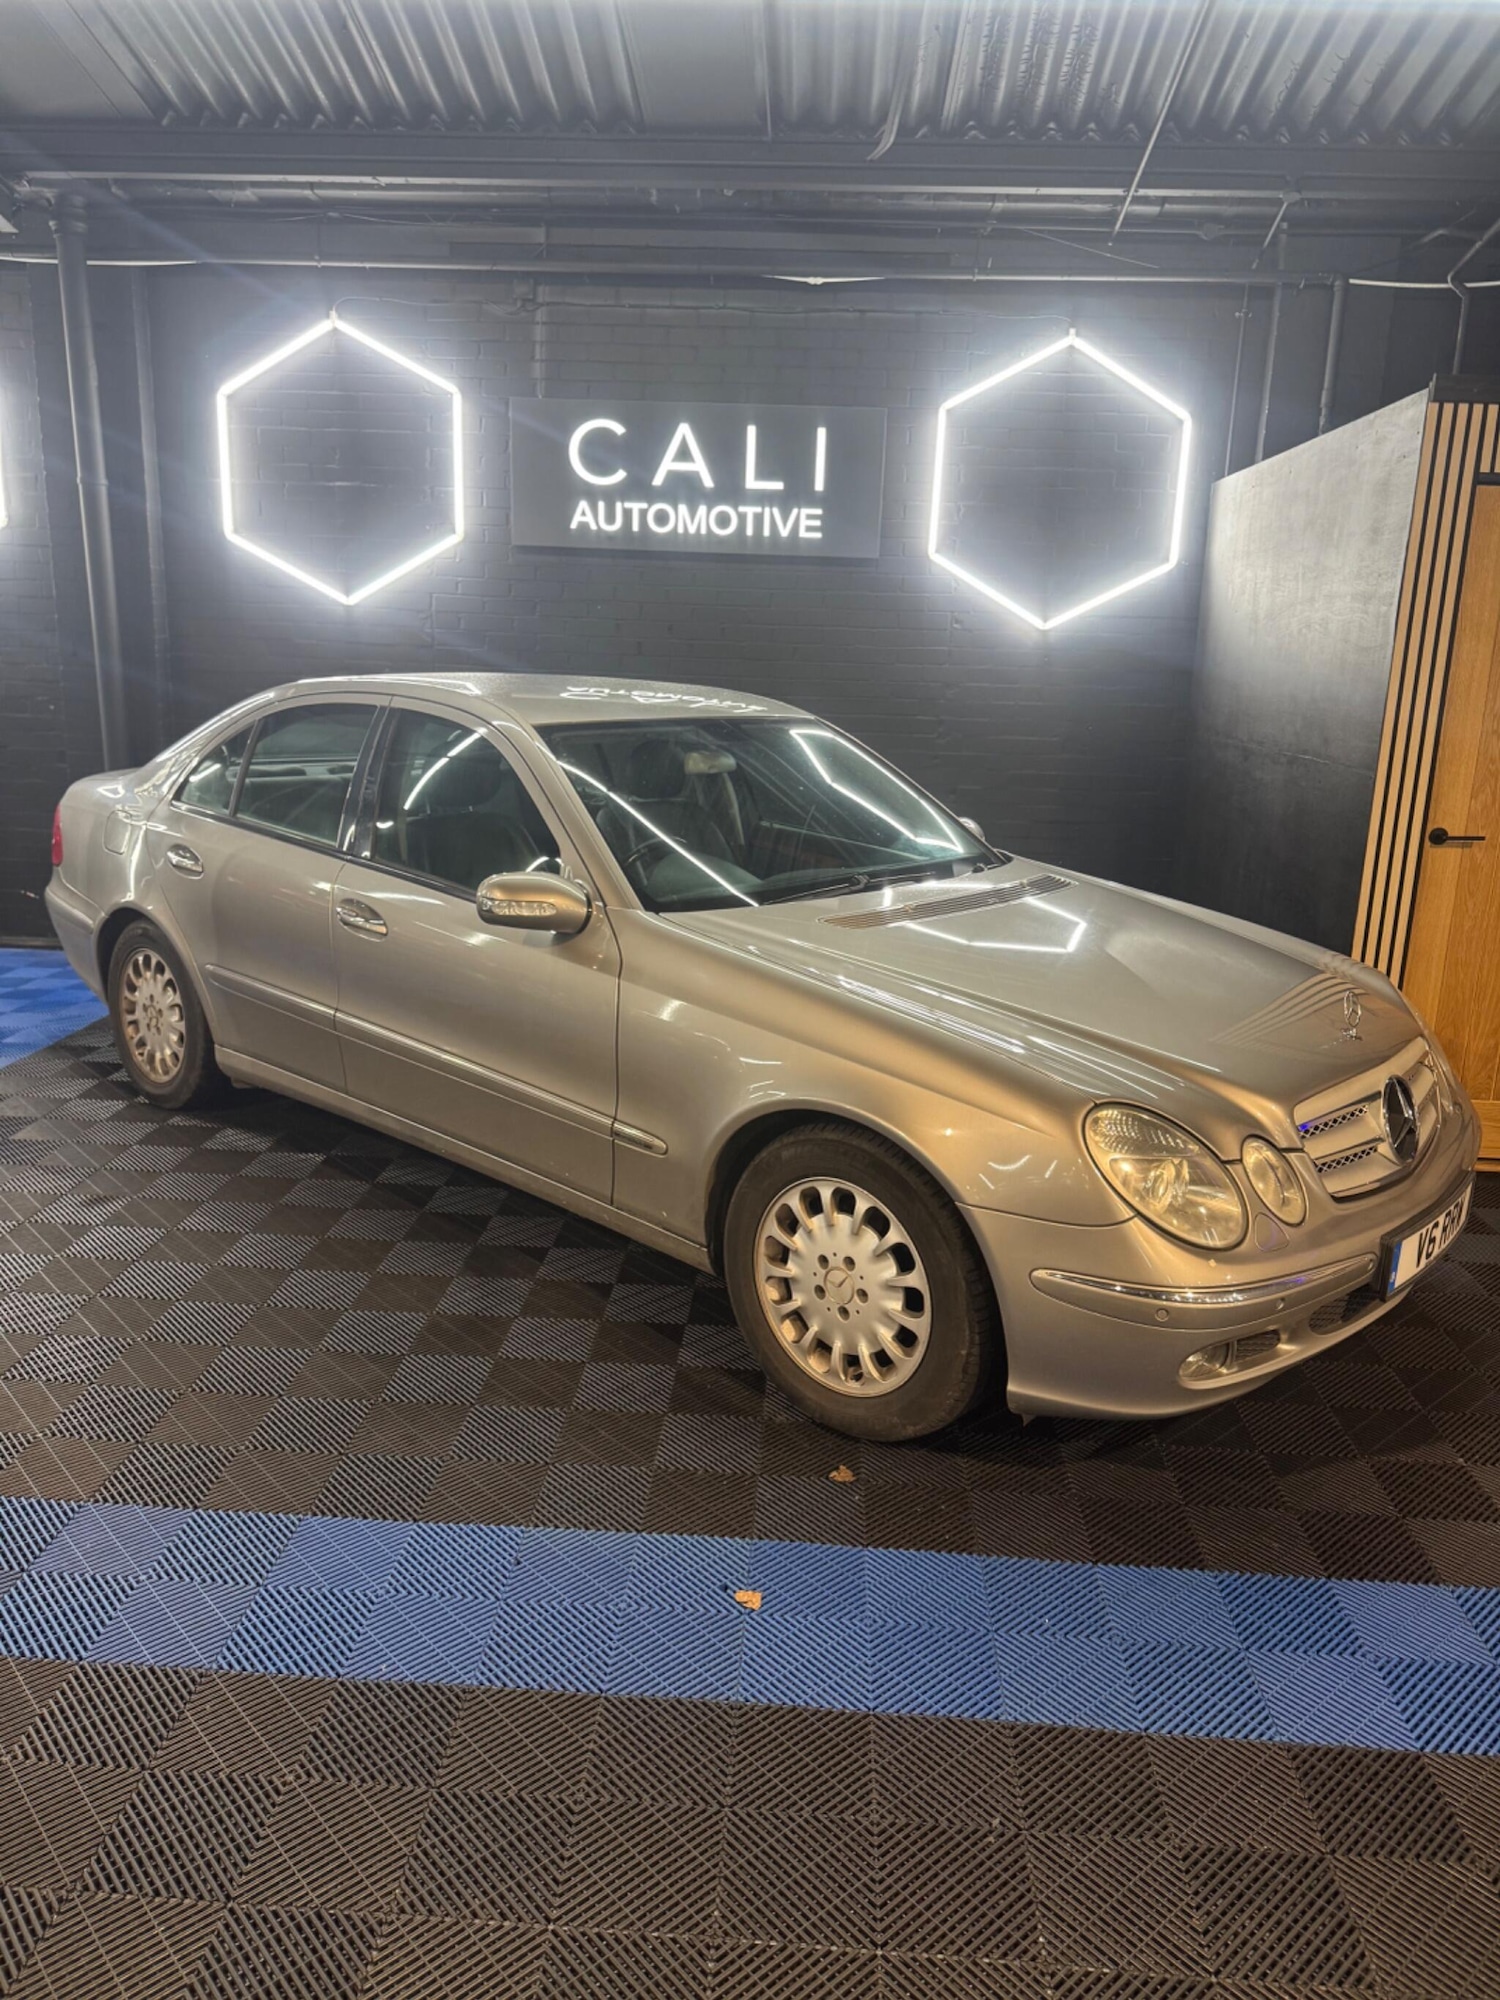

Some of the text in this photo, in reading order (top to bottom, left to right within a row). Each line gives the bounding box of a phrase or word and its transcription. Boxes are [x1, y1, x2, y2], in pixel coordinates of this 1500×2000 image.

[568, 418, 827, 492] CALI
[569, 500, 823, 538] AUTOMOTIVE
[1416, 1220, 1439, 1268] V6
